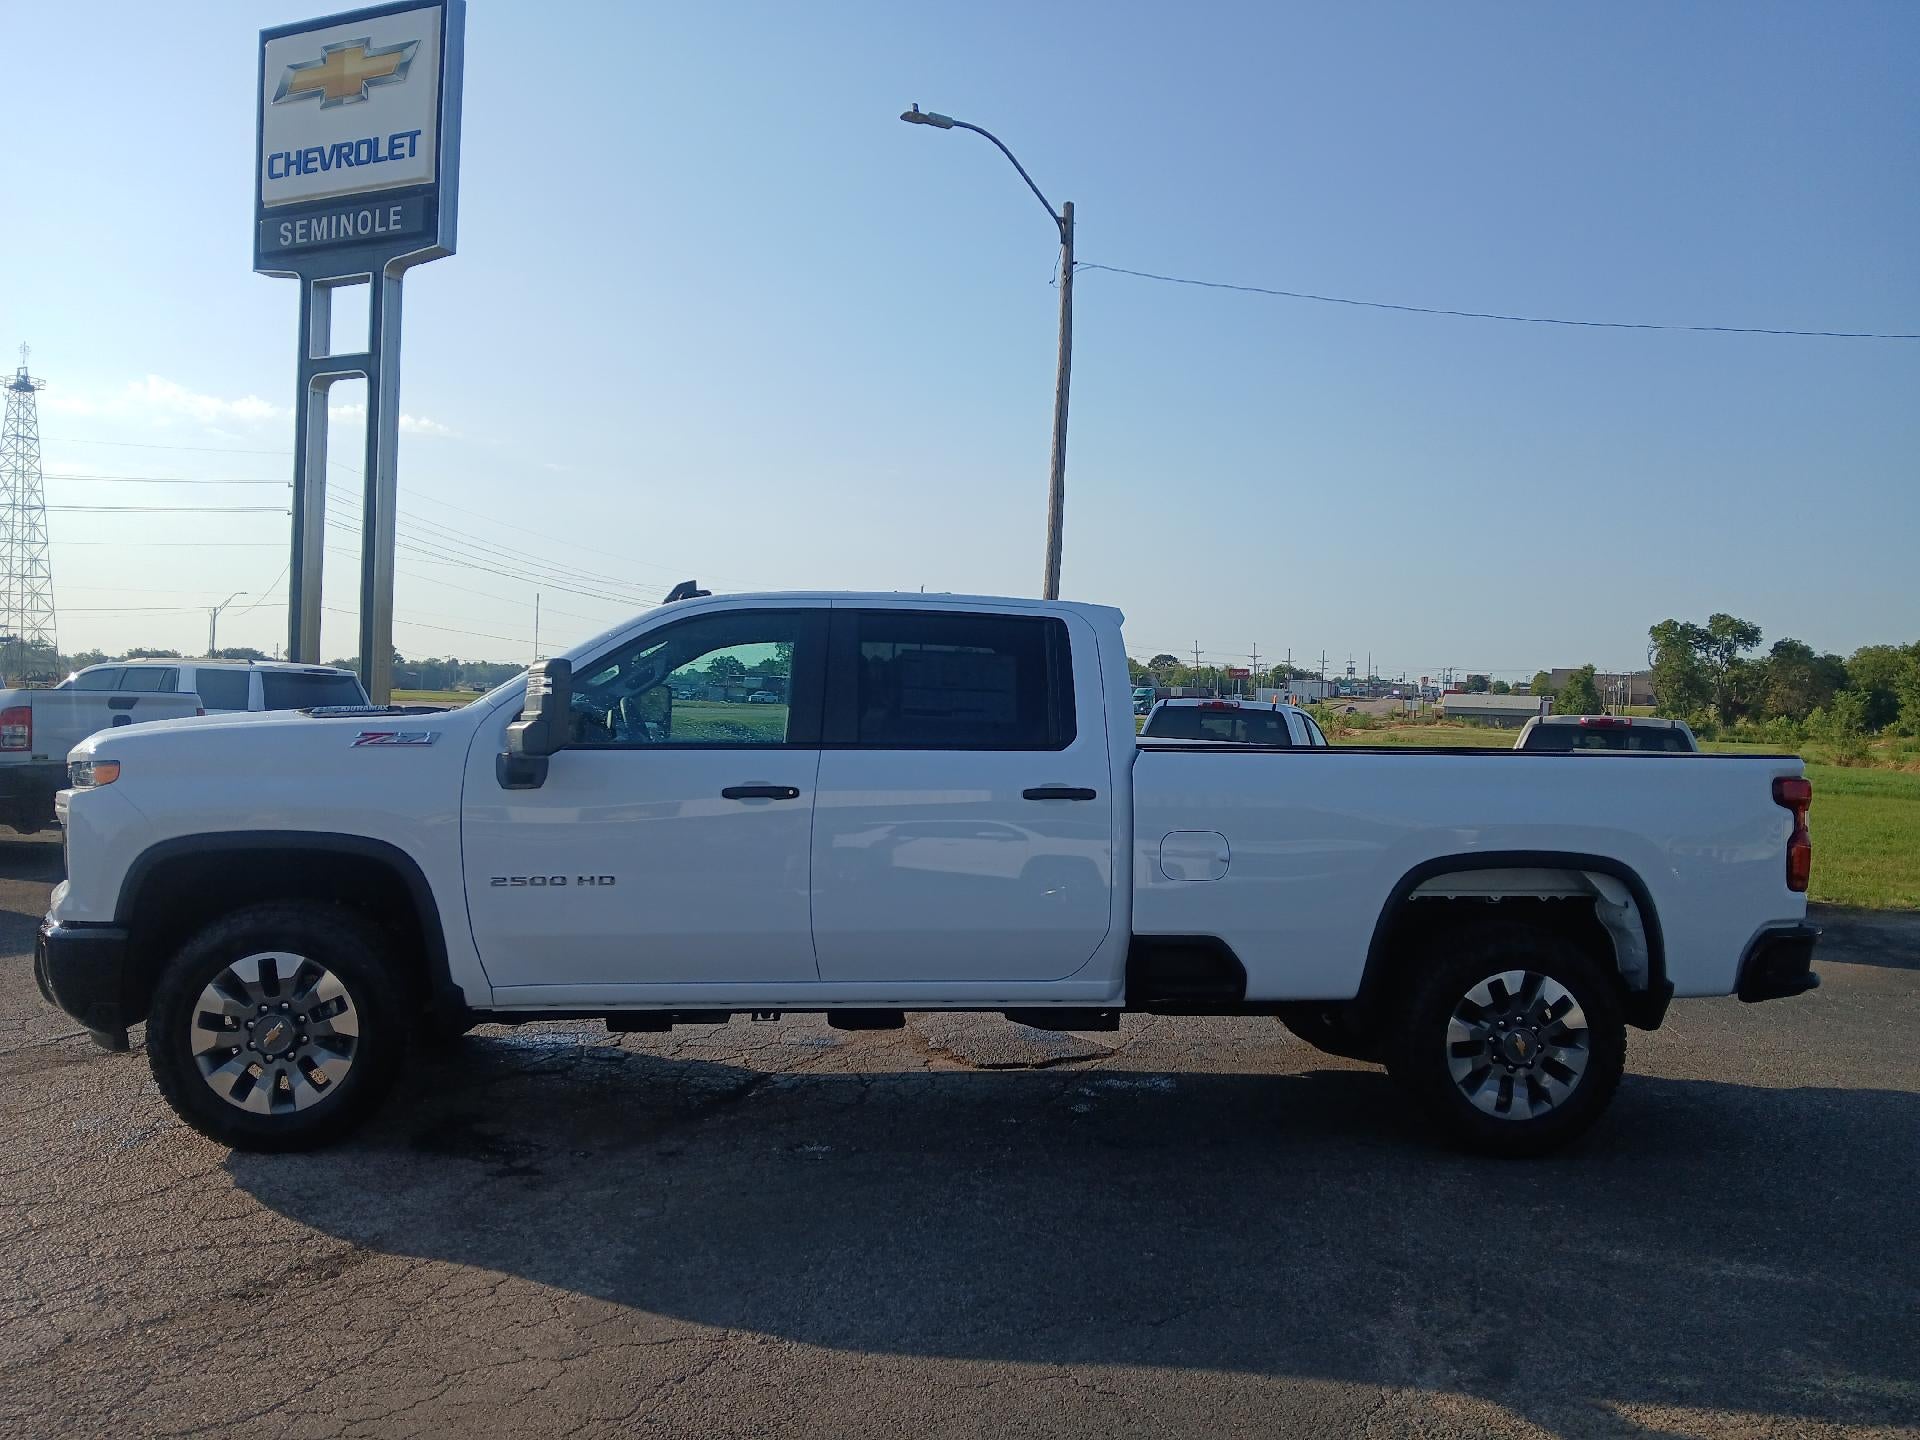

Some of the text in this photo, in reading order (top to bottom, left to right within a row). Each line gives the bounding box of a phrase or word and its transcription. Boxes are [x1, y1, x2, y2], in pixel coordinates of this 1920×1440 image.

[267, 129, 421, 180] CHEVROLET
[279, 206, 402, 246] SEMINOLE
[490, 875, 616, 887] 2500 HD
